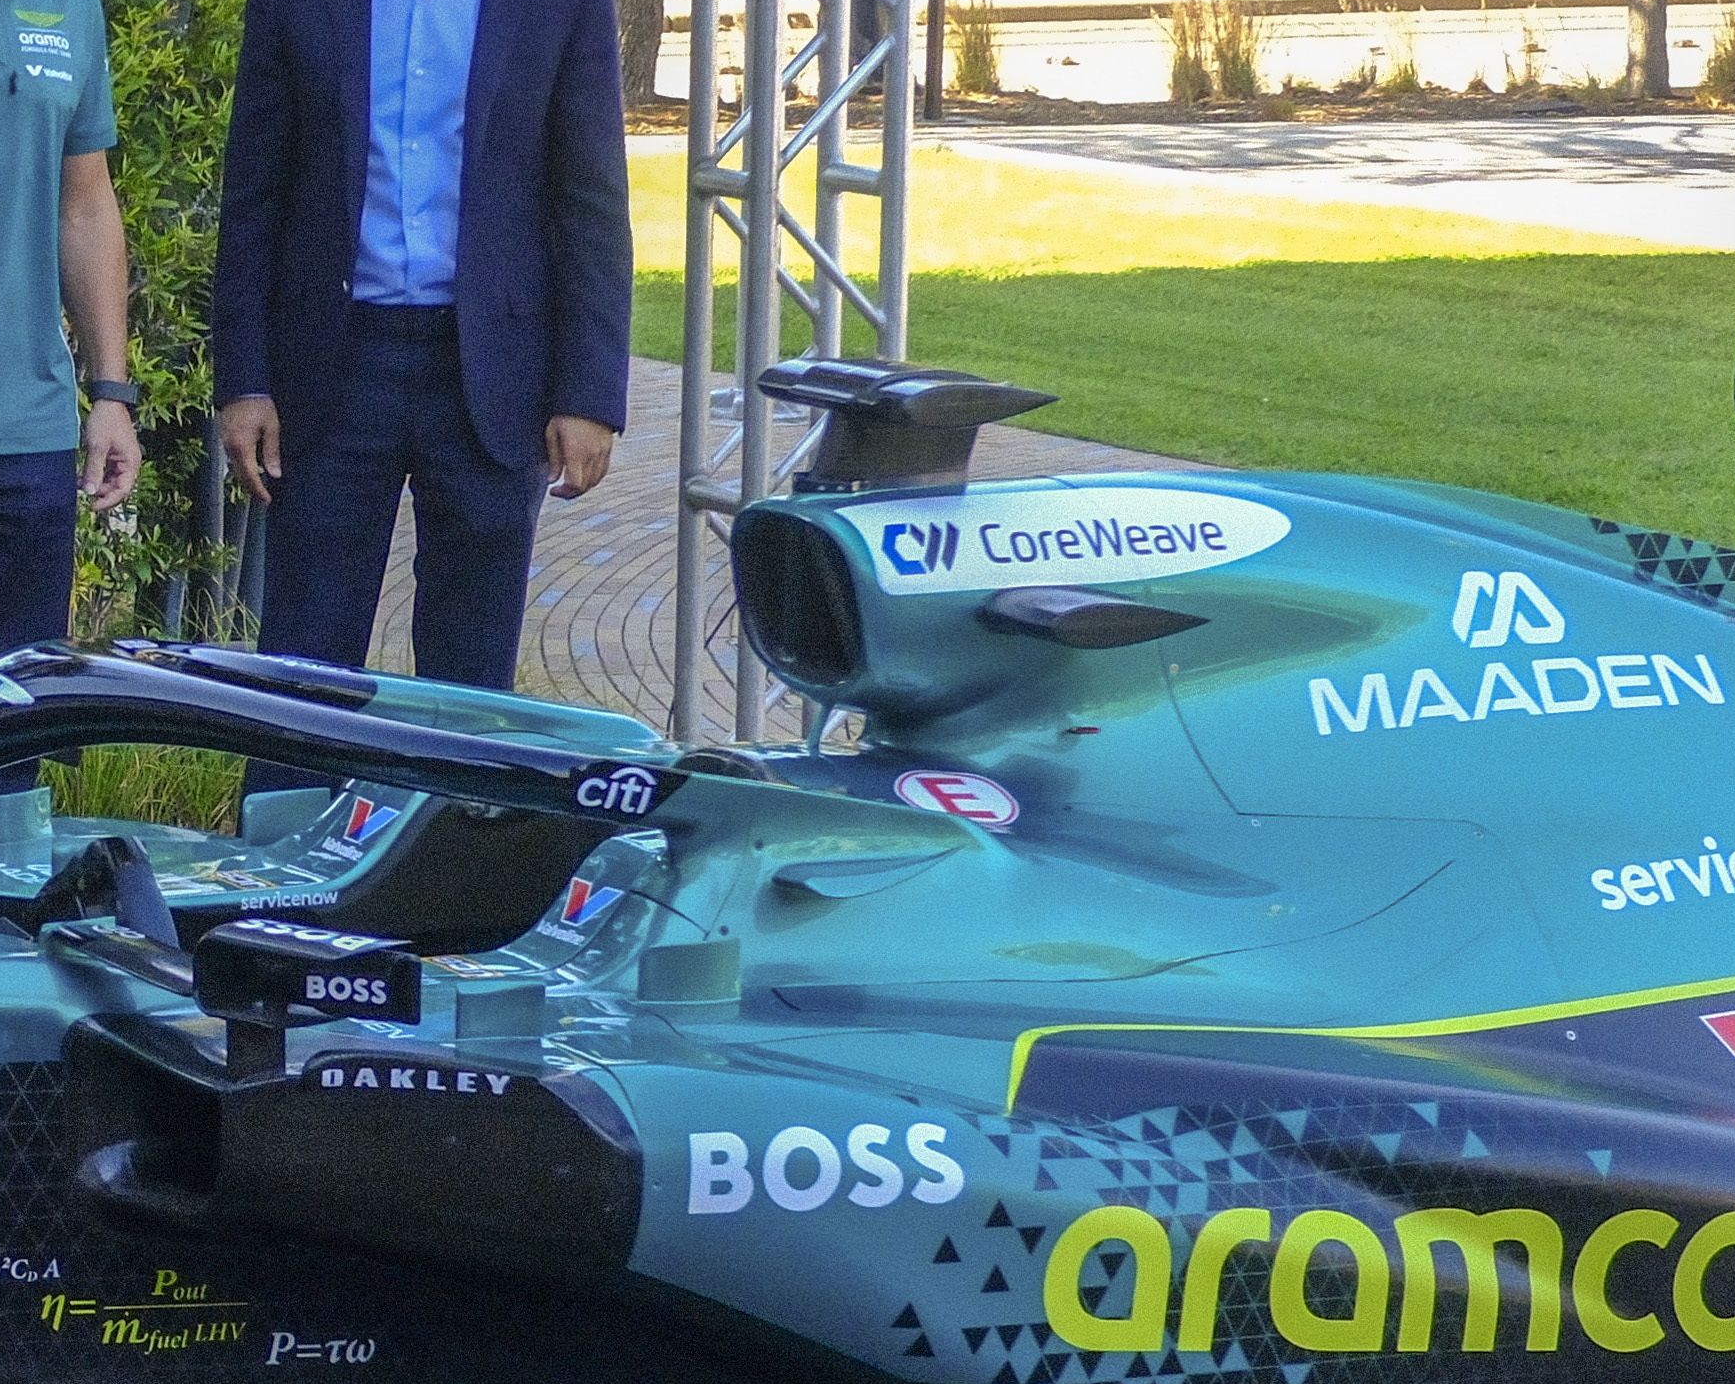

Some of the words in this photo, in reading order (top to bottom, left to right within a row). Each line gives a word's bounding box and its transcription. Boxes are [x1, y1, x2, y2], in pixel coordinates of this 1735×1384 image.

[19, 33, 70, 50] aramco
[979, 513, 1227, 567] CoreWeave
[1308, 651, 1726, 736] MAADEN
[576, 766, 658, 816] citi
[240, 890, 339, 911] servicenow
[305, 974, 389, 1006] BOSS
[320, 1067, 512, 1097] OAKLEY
[687, 1121, 967, 1217] BOSS
